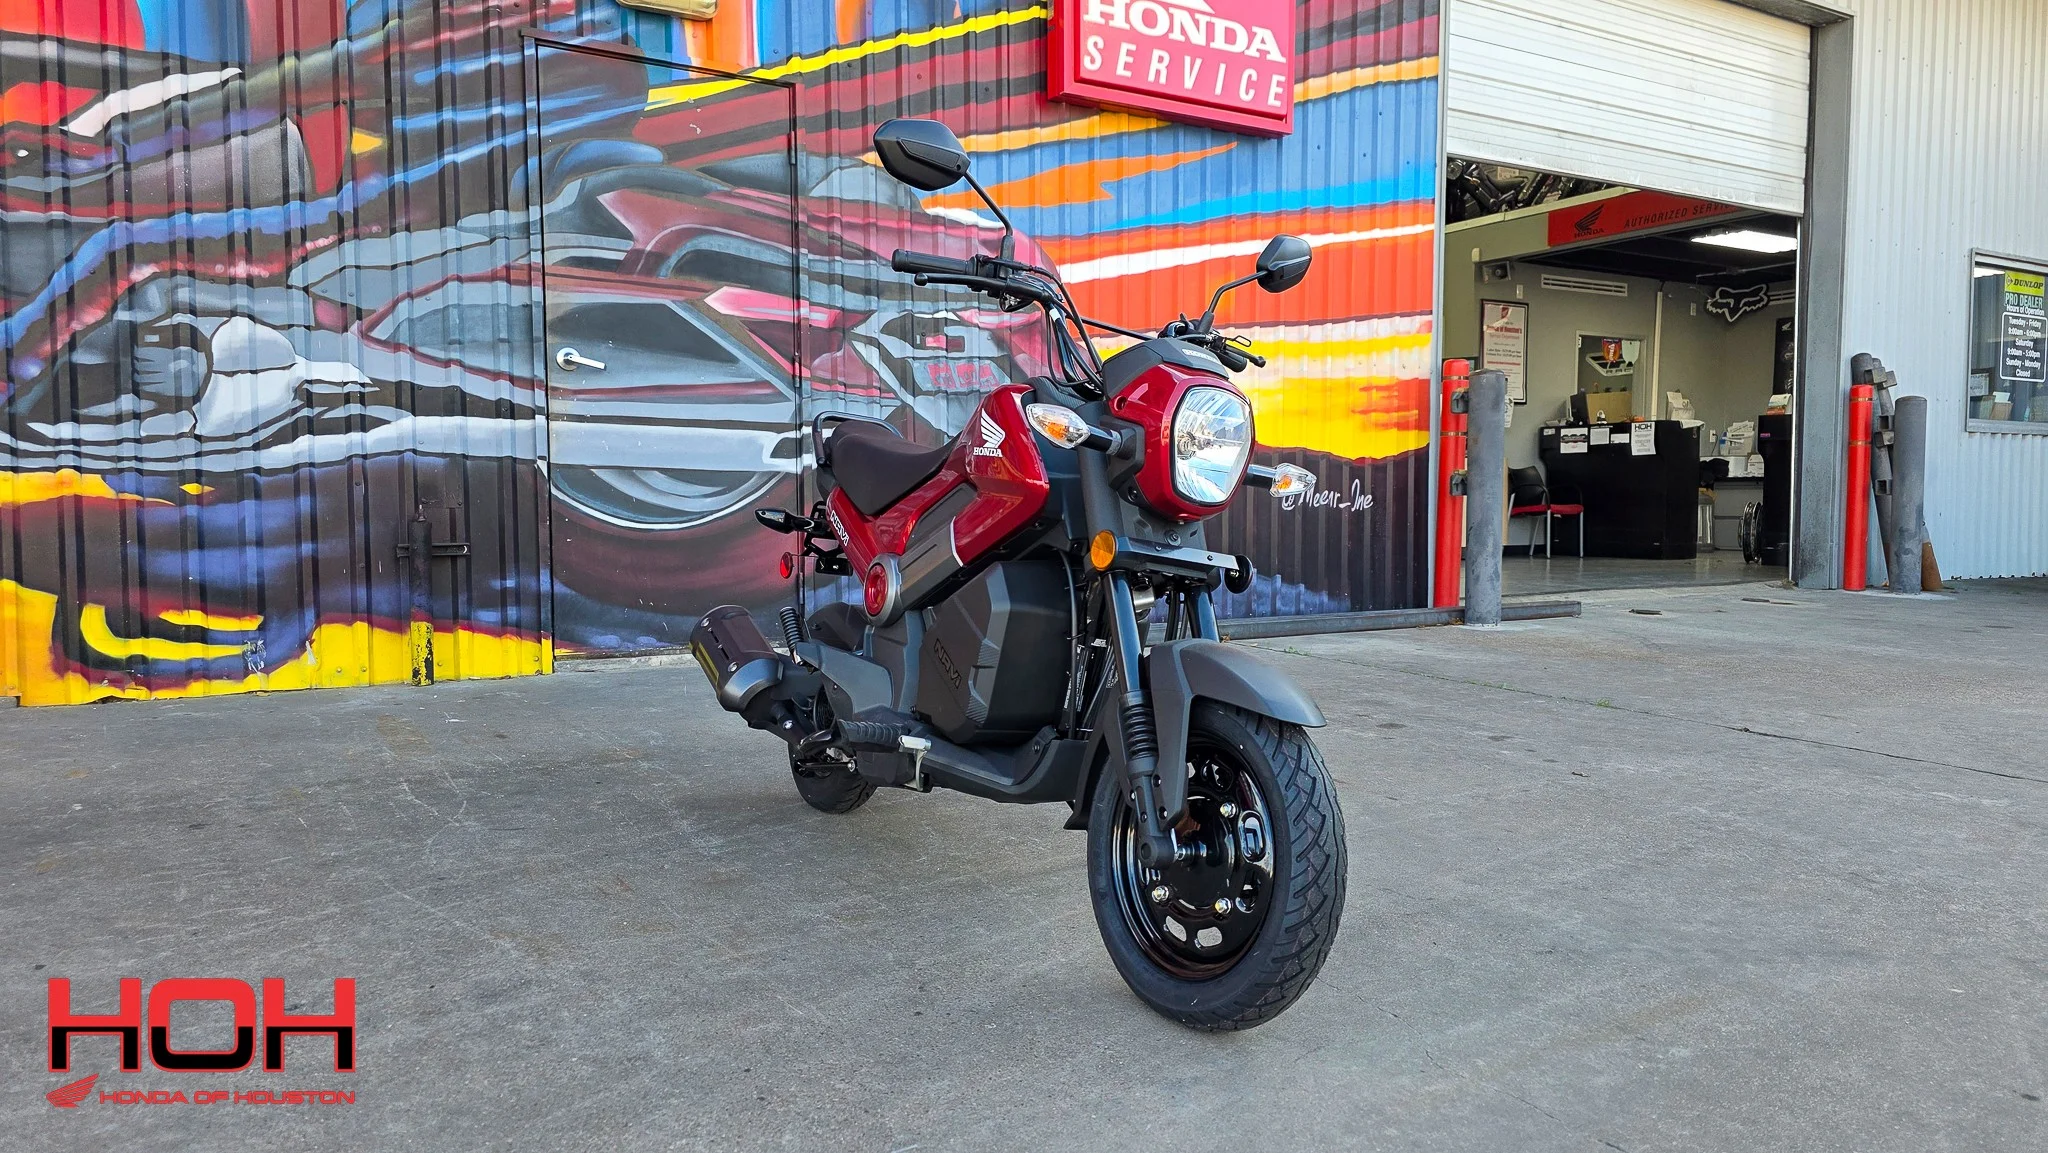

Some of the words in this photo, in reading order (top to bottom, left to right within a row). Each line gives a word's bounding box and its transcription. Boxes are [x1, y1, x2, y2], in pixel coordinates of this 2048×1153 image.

[1083, 0, 1287, 63] HONDA
[1083, 35, 1286, 107] SERVICE
[1624, 208, 1687, 228] AUTHORIZED
[1574, 228, 1604, 238] HONDA
[2013, 279, 2043, 289] DUNLOP
[2005, 292, 2018, 305] PRO
[2020, 294, 2043, 308] DEALER
[2006, 303, 2019, 312] Hours
[2025, 306, 2045, 316] Operation
[2009, 316, 2026, 327] Tuesday
[2029, 319, 2041, 329] Friday
[2015, 337, 2033, 348] Saturday
[2005, 357, 2022, 367] Sunday
[2025, 359, 2041, 369] Monday
[2015, 368, 2030, 377] Closed
[973, 446, 1003, 458] HONDA
[830, 509, 849, 547] NAVI
[934, 637, 961, 690] NAVI
